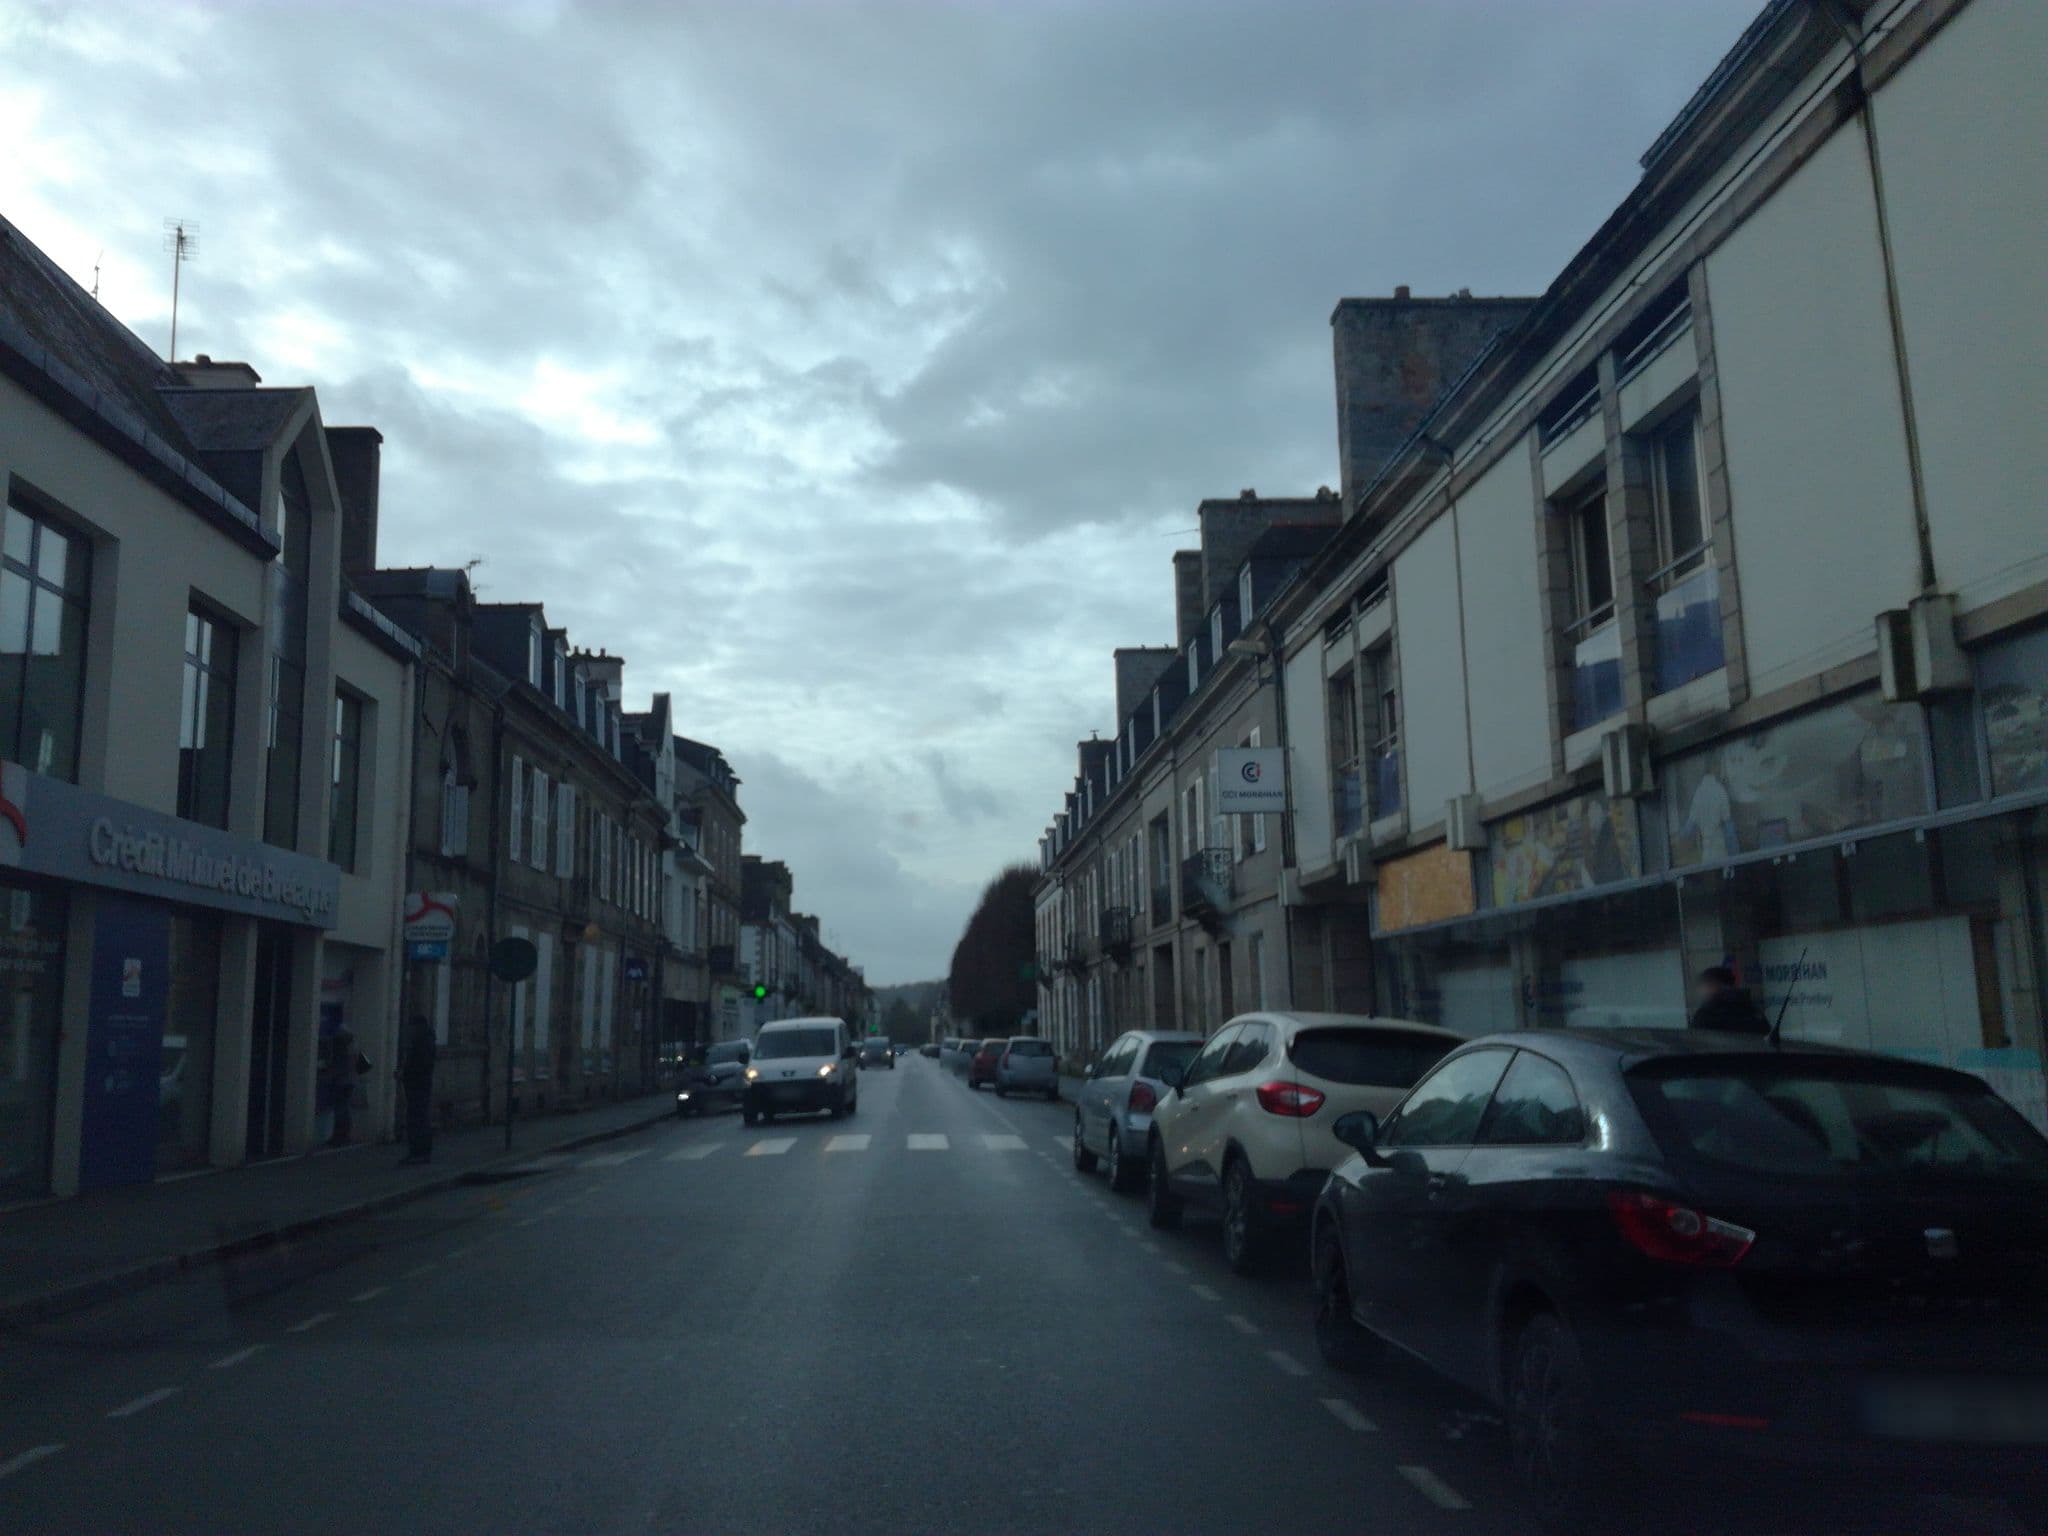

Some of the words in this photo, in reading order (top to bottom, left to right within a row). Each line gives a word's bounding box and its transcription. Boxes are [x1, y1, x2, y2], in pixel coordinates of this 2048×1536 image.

[90, 817, 164, 876] Crédit
[168, 839, 237, 892] Mutuel
[238, 856, 263, 899] de
[263, 864, 332, 921] Bretagne
